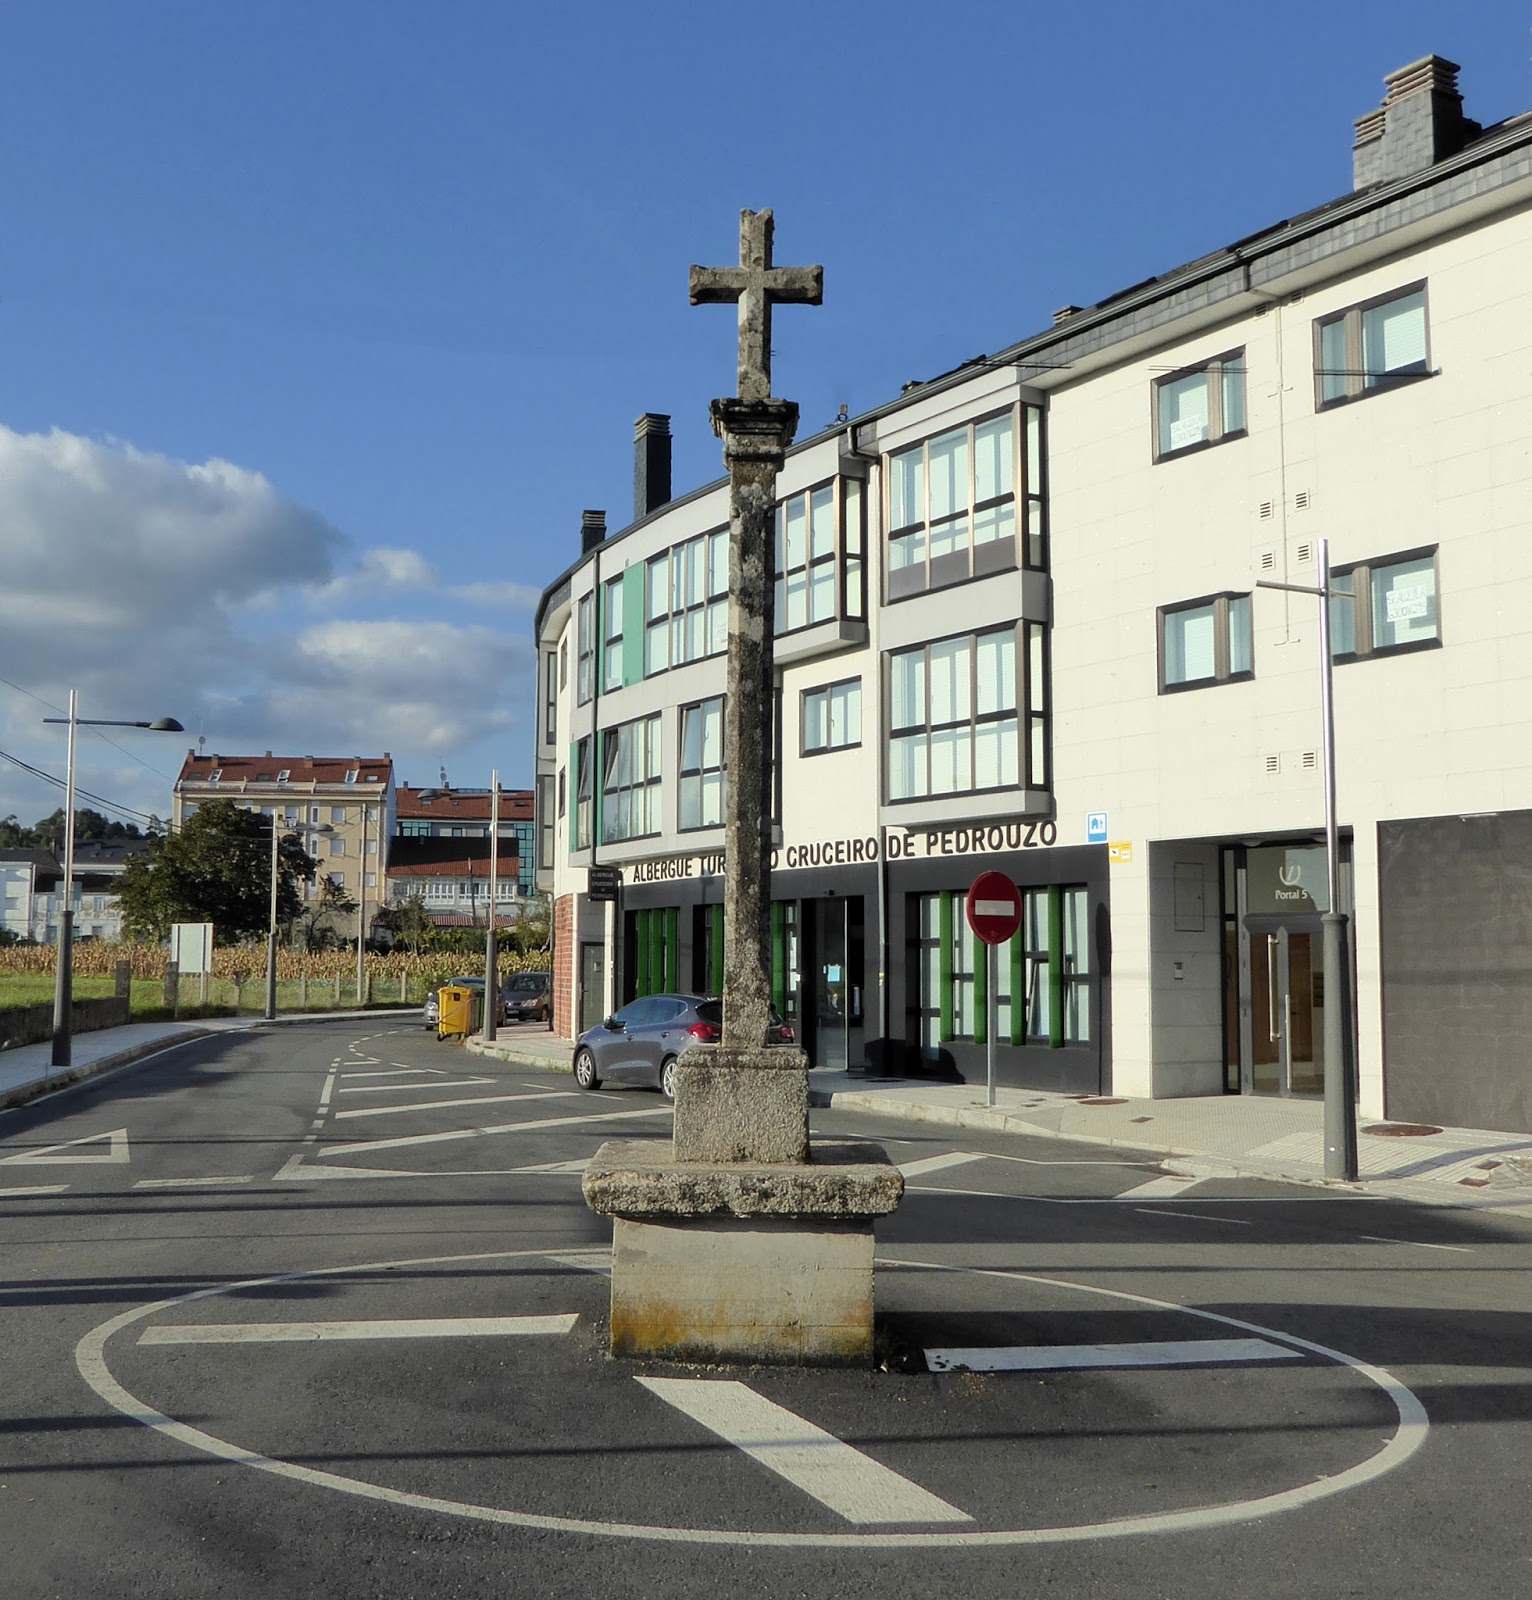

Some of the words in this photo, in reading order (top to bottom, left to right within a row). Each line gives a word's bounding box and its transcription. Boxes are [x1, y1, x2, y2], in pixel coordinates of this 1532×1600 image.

[633, 858, 693, 883] ALBERGUE
[787, 837, 879, 868] CRUCEIRO
[888, 833, 916, 858] DE
[926, 820, 1058, 856] PEDROUZO
[1275, 889, 1300, 900] Portal
[1301, 889, 1308, 899] 5
